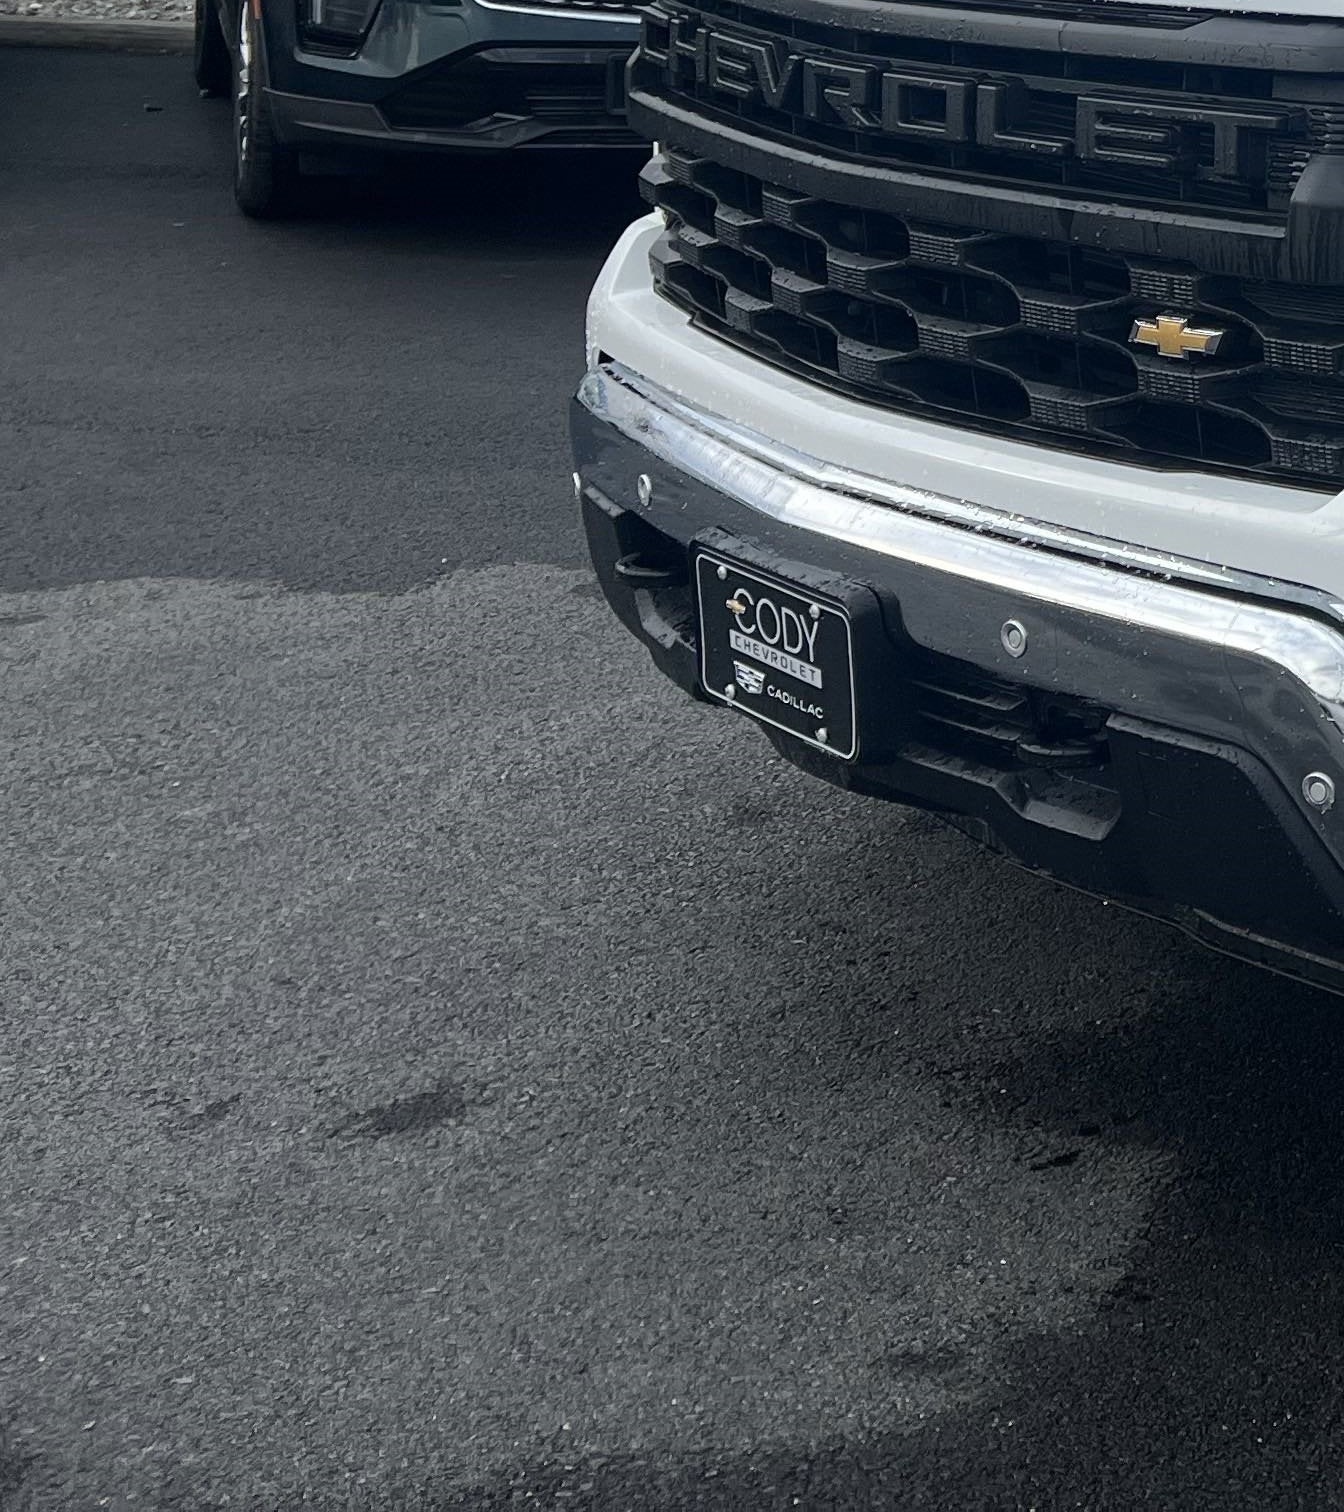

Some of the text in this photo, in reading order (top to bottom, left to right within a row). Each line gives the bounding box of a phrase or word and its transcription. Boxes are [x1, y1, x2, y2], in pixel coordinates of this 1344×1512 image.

[640, 2, 1293, 180] CHEVROLET
[731, 588, 819, 663] CODY
[734, 635, 817, 683] CHEVROLET
[766, 684, 824, 719] CADILLAC
